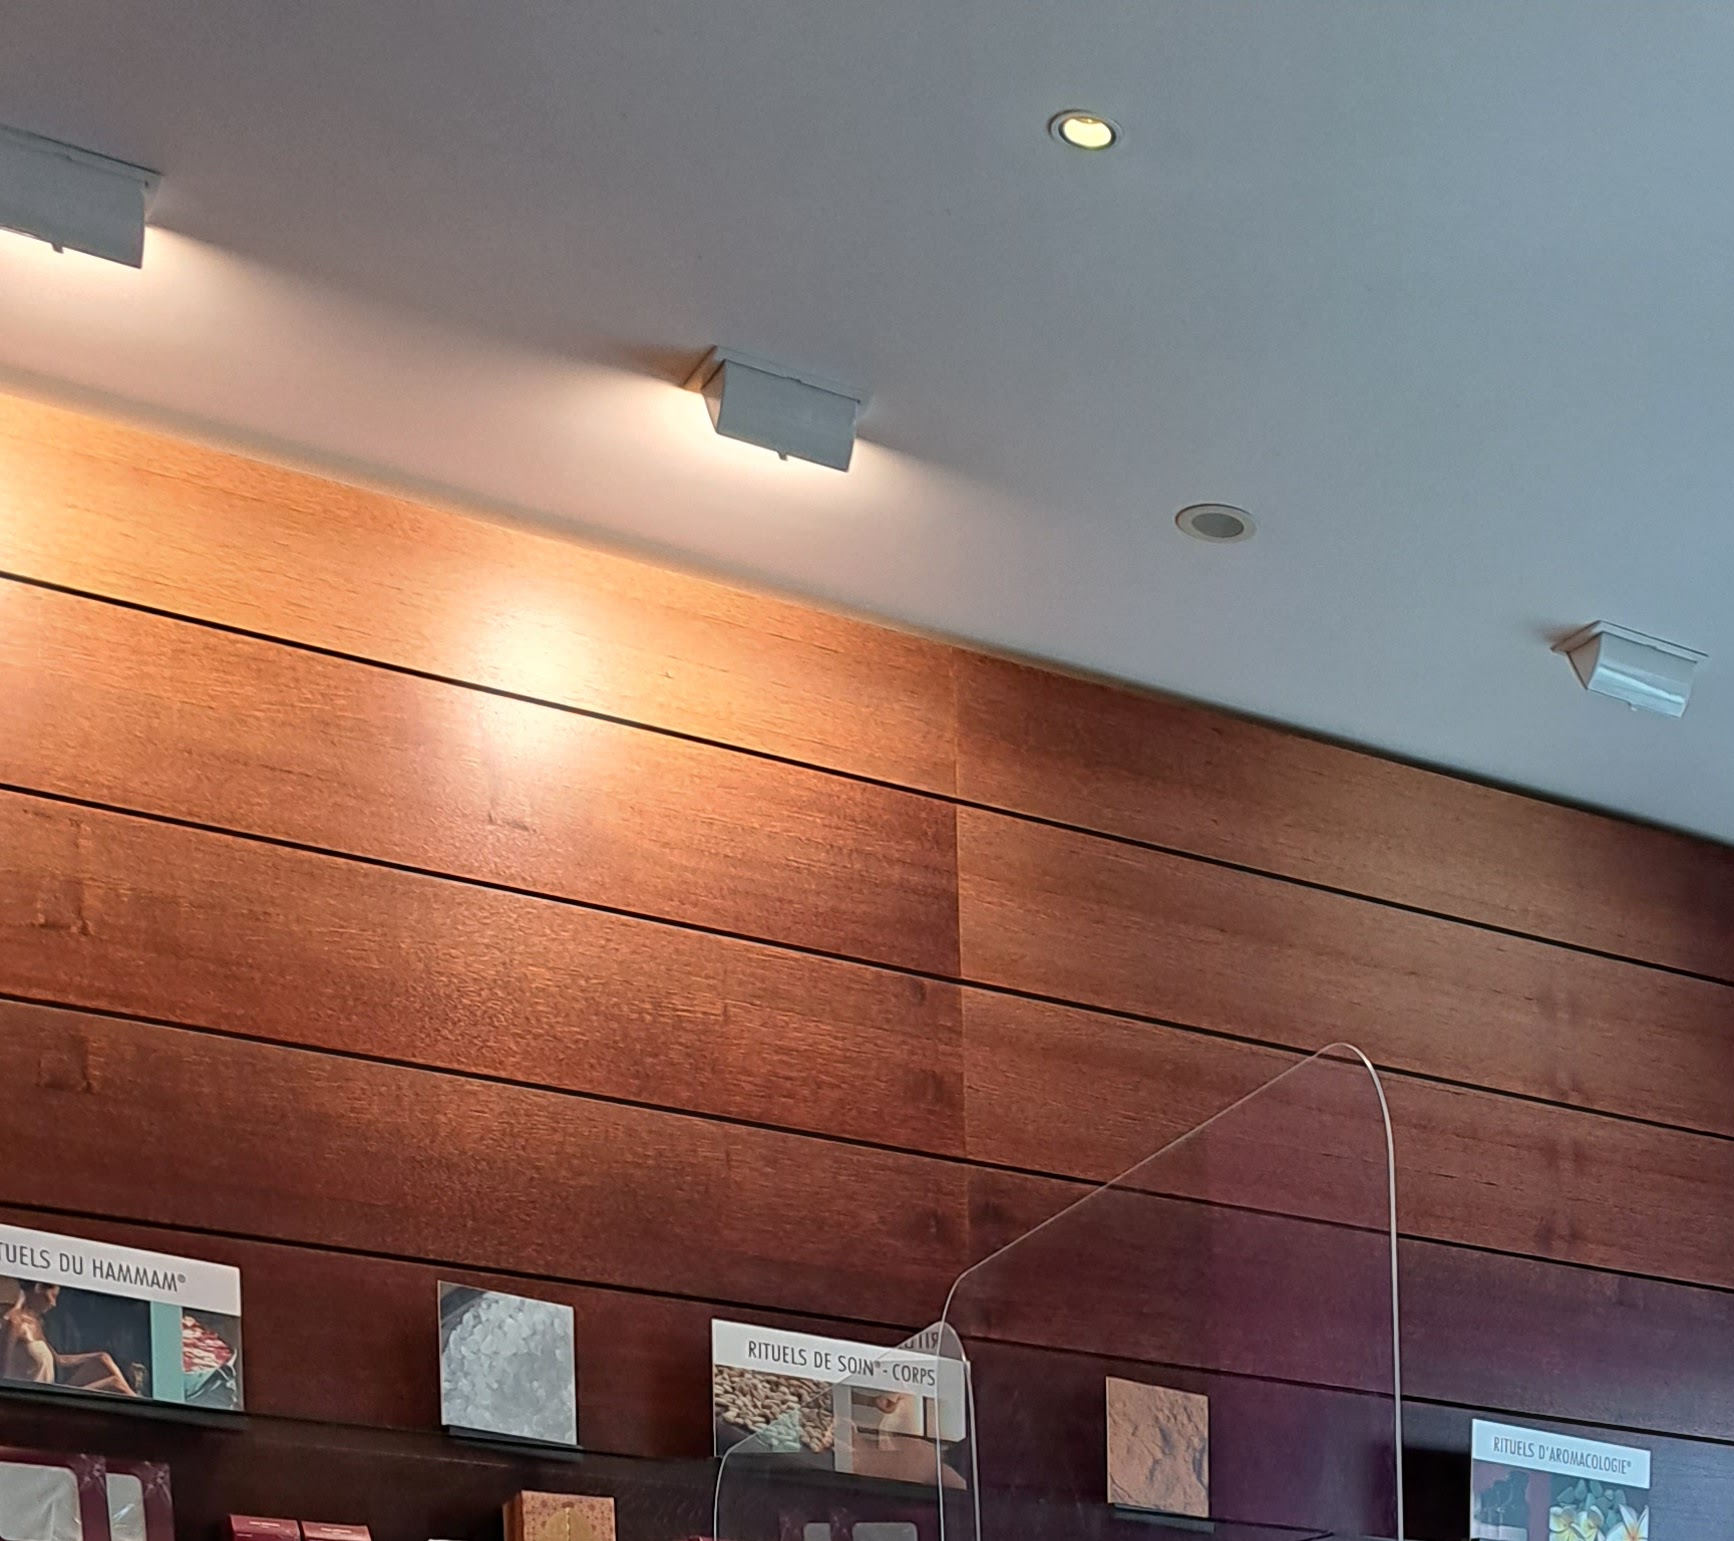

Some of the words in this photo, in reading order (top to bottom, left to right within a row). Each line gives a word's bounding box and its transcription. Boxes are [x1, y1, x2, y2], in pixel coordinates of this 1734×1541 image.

[59, 1253, 84, 1275] DU
[748, 1340, 807, 1366] RITUELS
[813, 1352, 832, 1371] DE
[892, 1363, 936, 1386] CORPS
[1493, 1436, 1535, 1458] RITUELS
